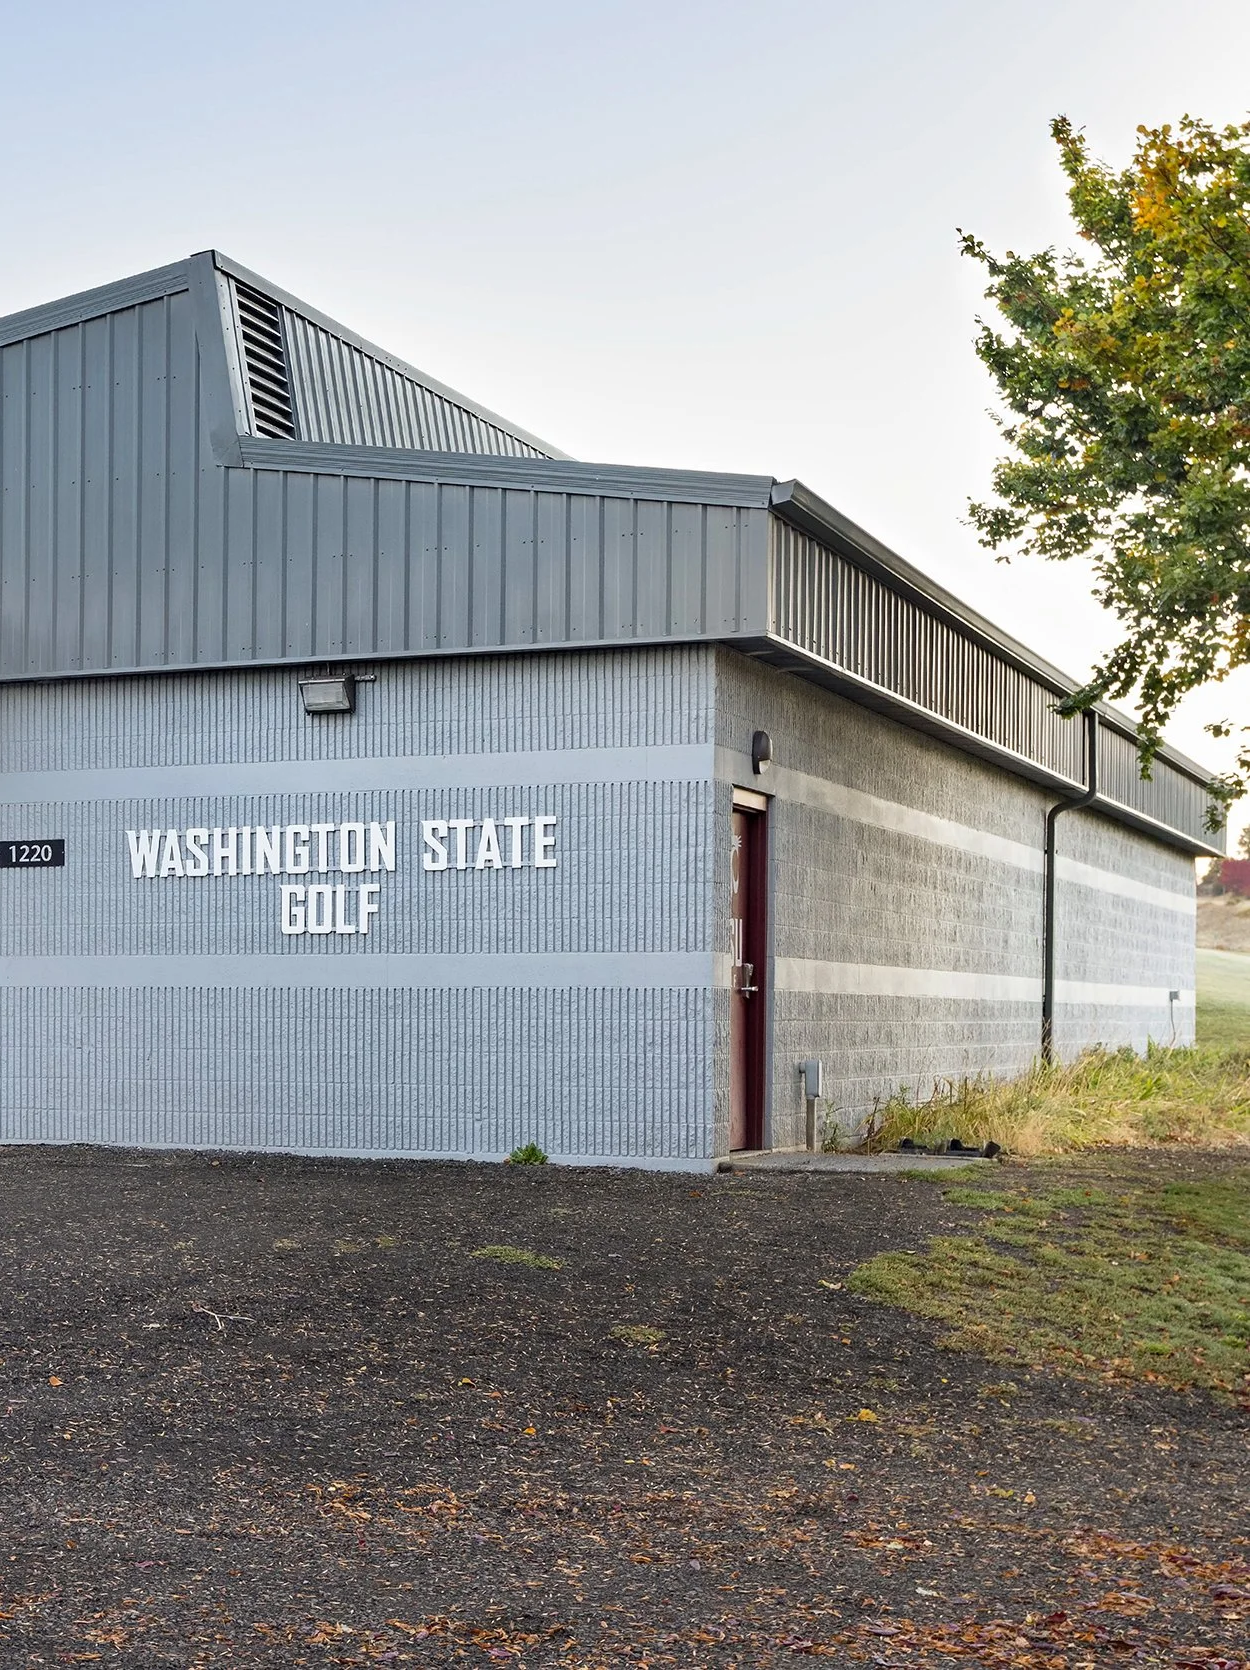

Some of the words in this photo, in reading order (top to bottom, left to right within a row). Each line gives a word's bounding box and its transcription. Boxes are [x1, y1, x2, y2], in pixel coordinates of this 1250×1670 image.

[9, 844, 52, 863] 1220
[125, 821, 396, 878] WASHINGTON
[421, 815, 557, 871] STATE
[279, 883, 380, 934] GOLF
